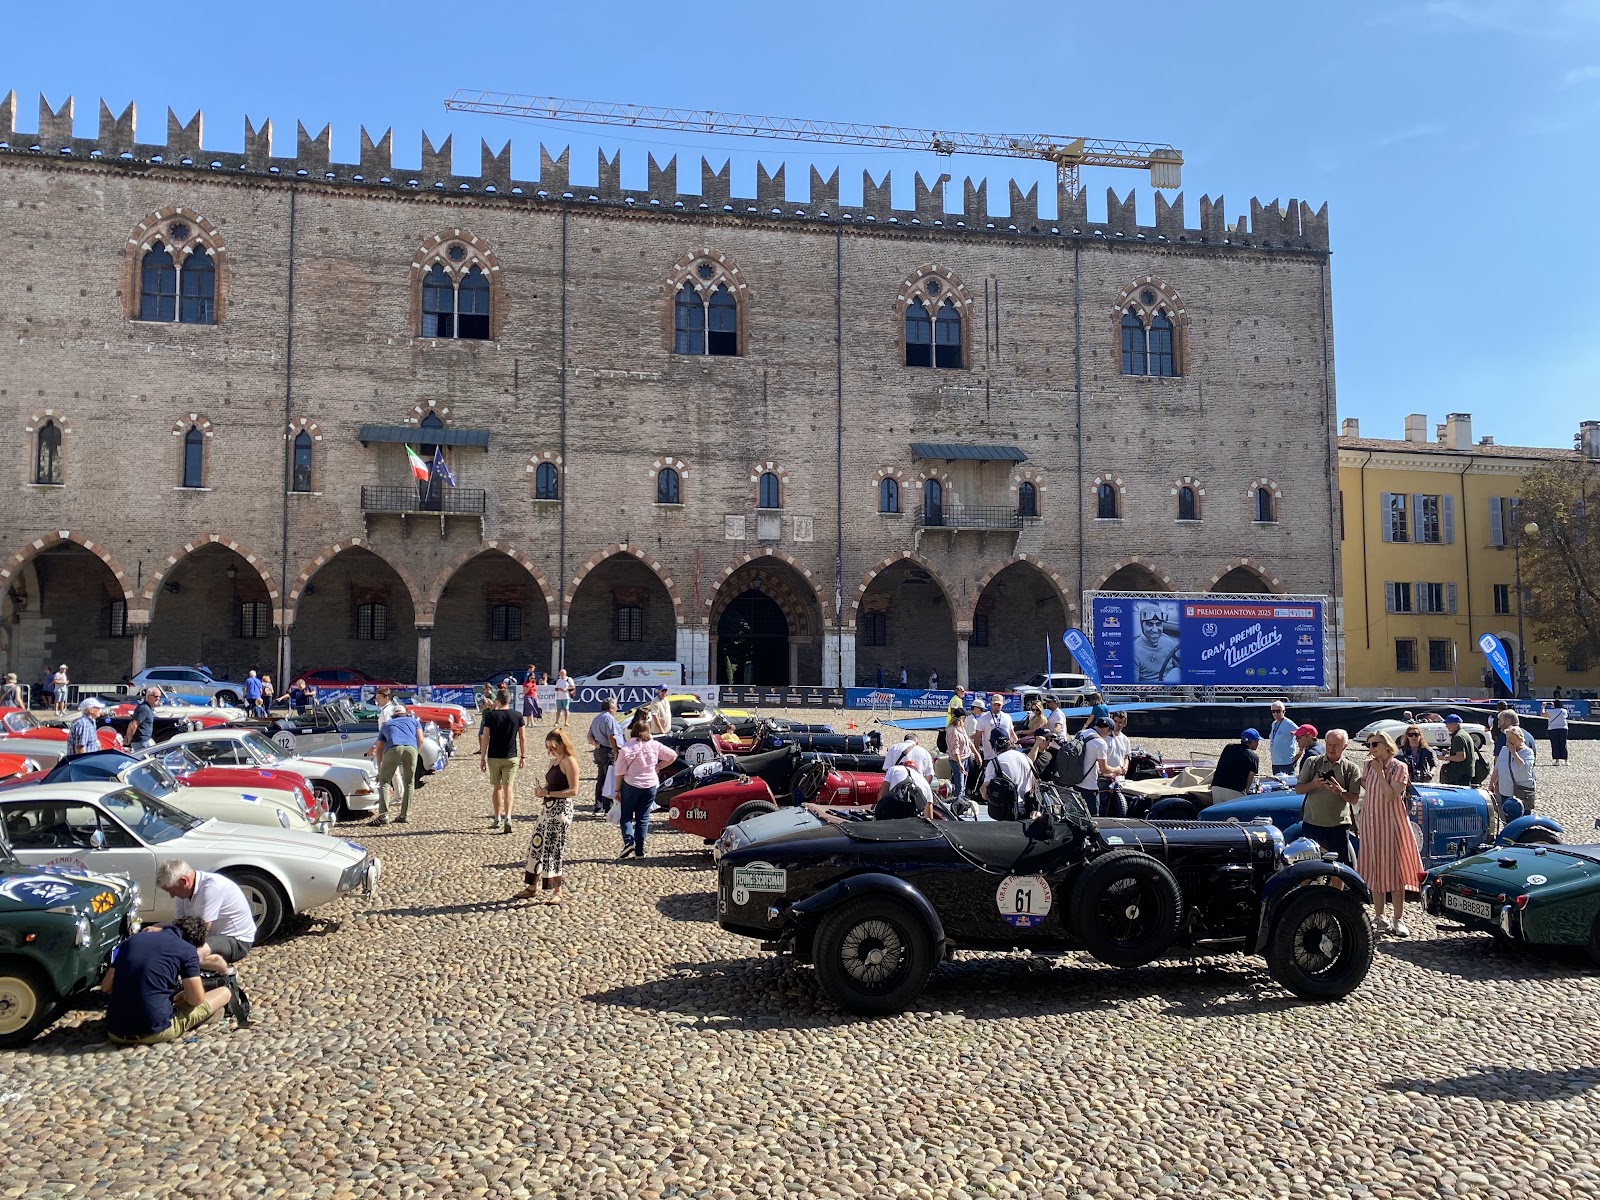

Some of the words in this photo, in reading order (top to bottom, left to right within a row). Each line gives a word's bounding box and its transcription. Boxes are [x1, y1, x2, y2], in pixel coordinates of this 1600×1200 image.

[1202, 642, 1225, 660] GRAN
[1230, 623, 1261, 646] PREMIO
[1224, 626, 1282, 666] Nuvolari
[278, 739, 289, 748] 112
[696, 752, 704, 763] 87
[703, 766, 712, 775] 58
[46, 857, 72, 866] PREMIO
[737, 873, 752, 884] FLYING
[756, 875, 783, 886] SCOTSMAN
[737, 890, 744, 902] 61
[999, 882, 1009, 901] GRAN
[1016, 889, 1031, 912] 61
[1448, 896, 1458, 907] BG
